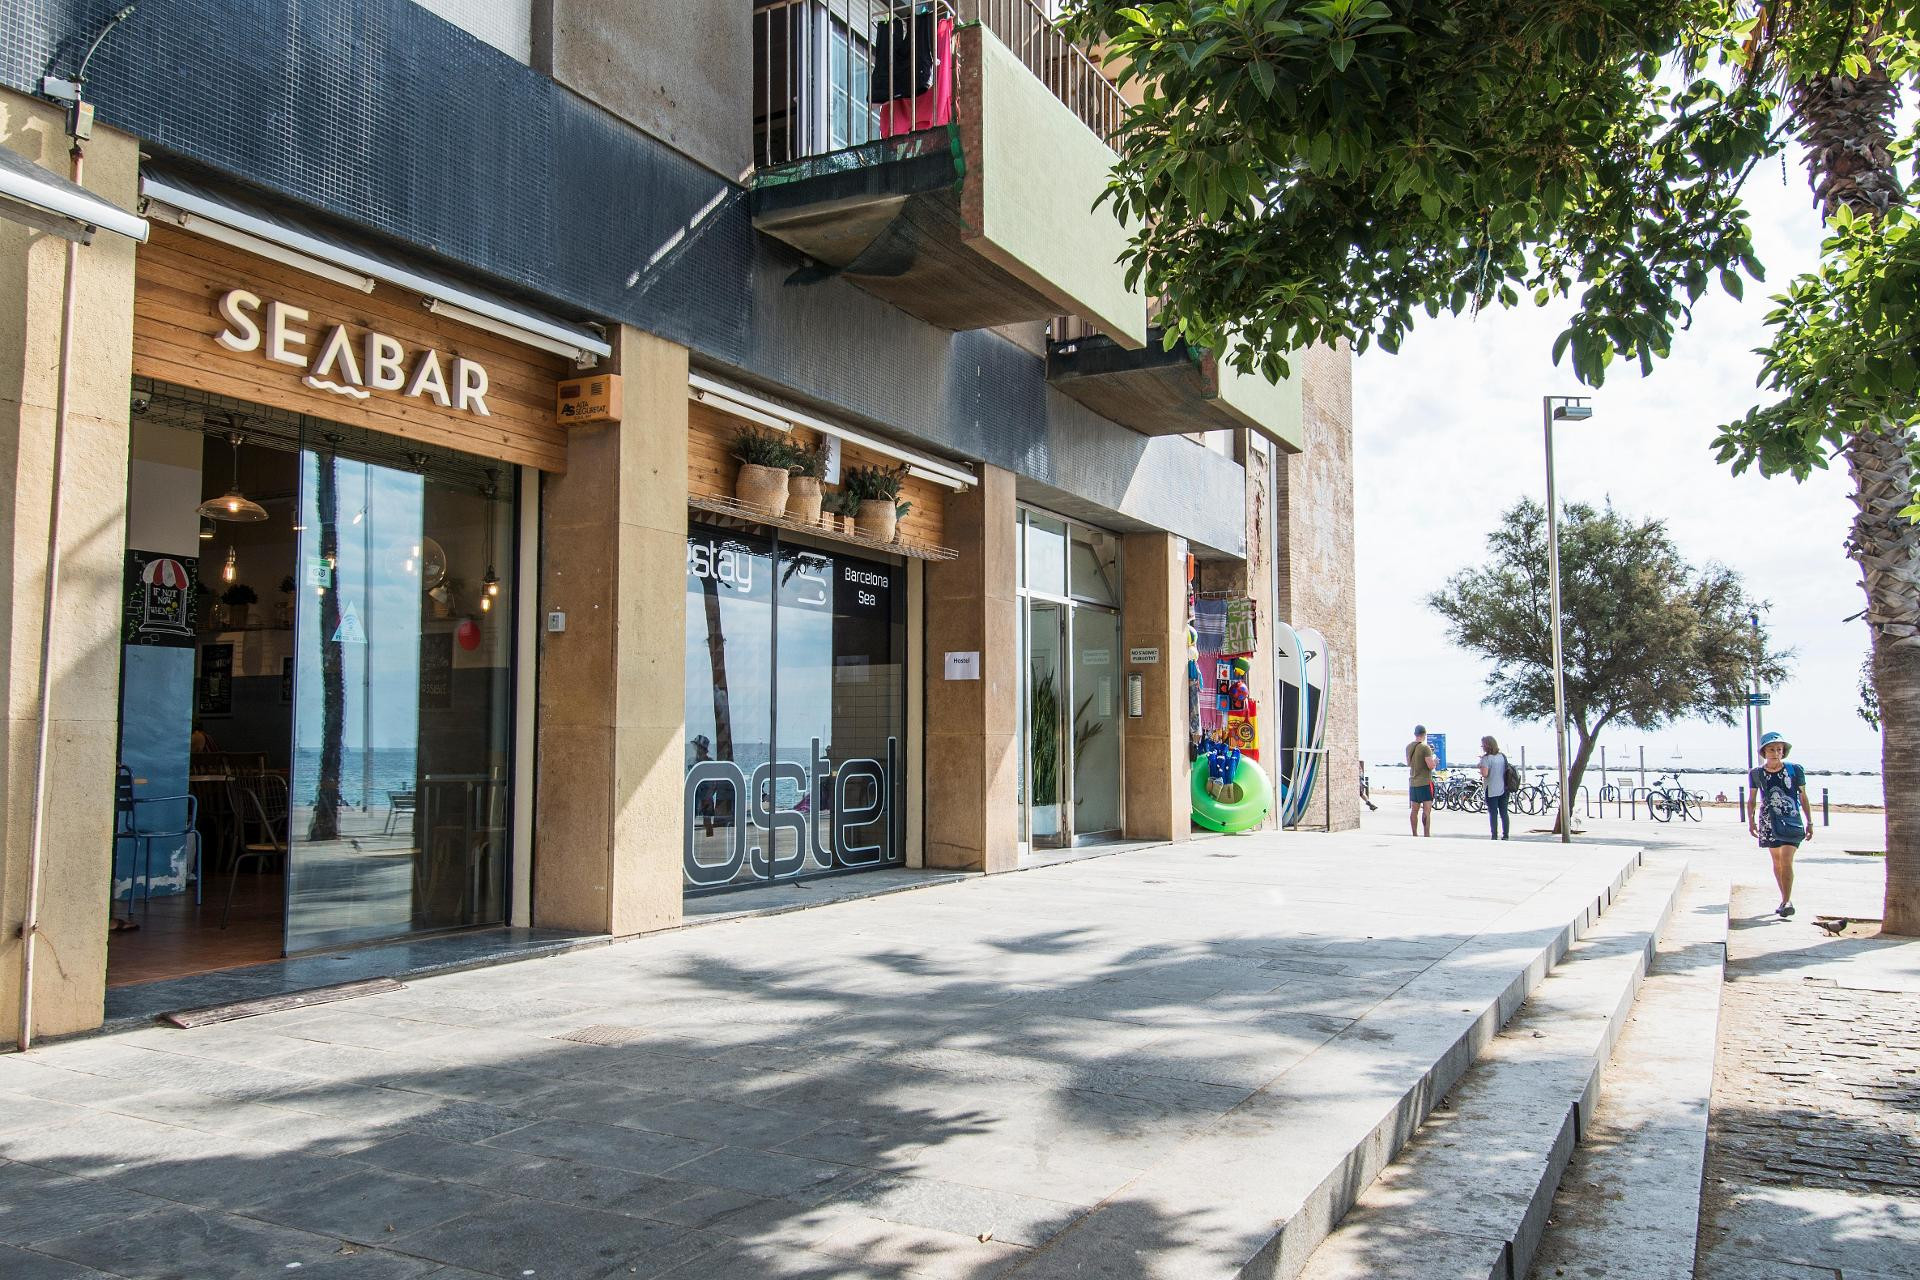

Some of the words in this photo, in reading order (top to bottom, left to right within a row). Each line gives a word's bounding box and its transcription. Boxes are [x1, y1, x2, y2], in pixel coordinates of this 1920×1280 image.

[214, 289, 490, 417] SEABAR
[844, 567, 889, 588] Barcelona
[153, 588, 161, 596] IF
[162, 588, 177, 597] NOT
[858, 590, 876, 606] Sea
